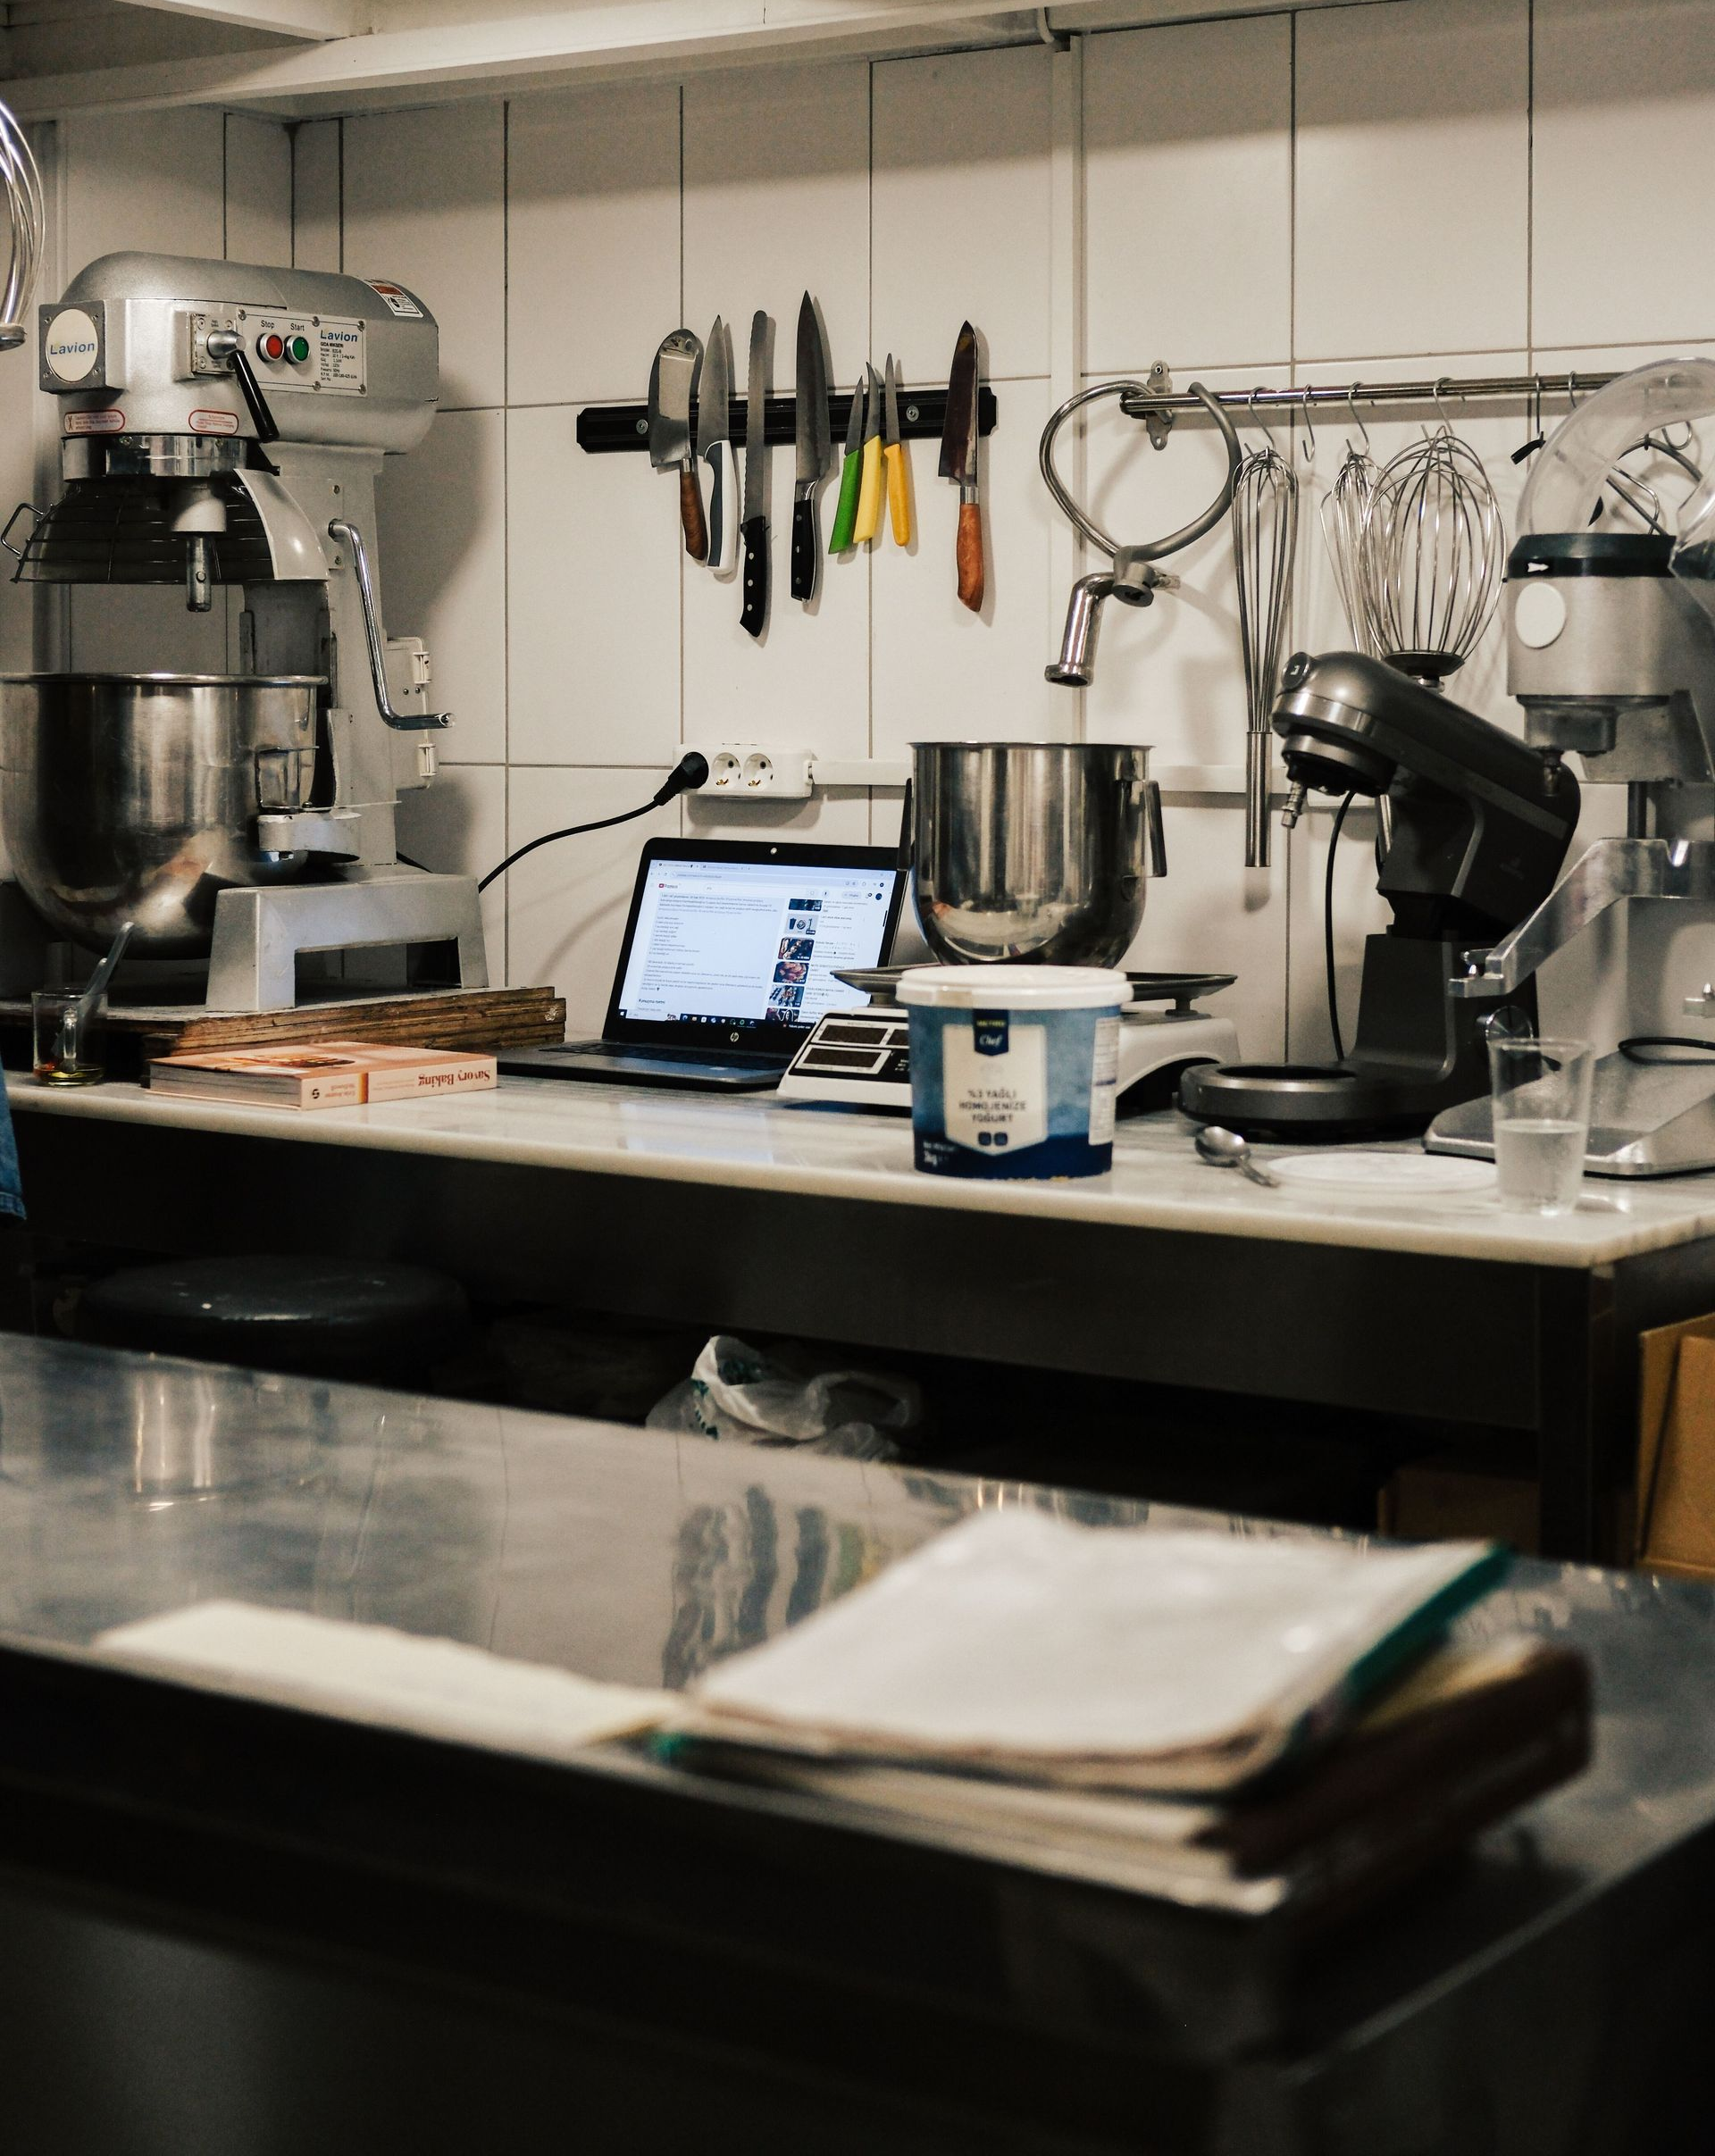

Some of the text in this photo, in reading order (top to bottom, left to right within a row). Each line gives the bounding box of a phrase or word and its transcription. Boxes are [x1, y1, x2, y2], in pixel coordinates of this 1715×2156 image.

[261, 320, 275, 329] Stop
[290, 322, 305, 331] Start
[321, 330, 357, 342] Lavion
[50, 341, 95, 355] Lavion
[979, 1034, 1002, 1047] Chef
[418, 1073, 455, 1088] Baking
[457, 1069, 490, 1082] Savory
